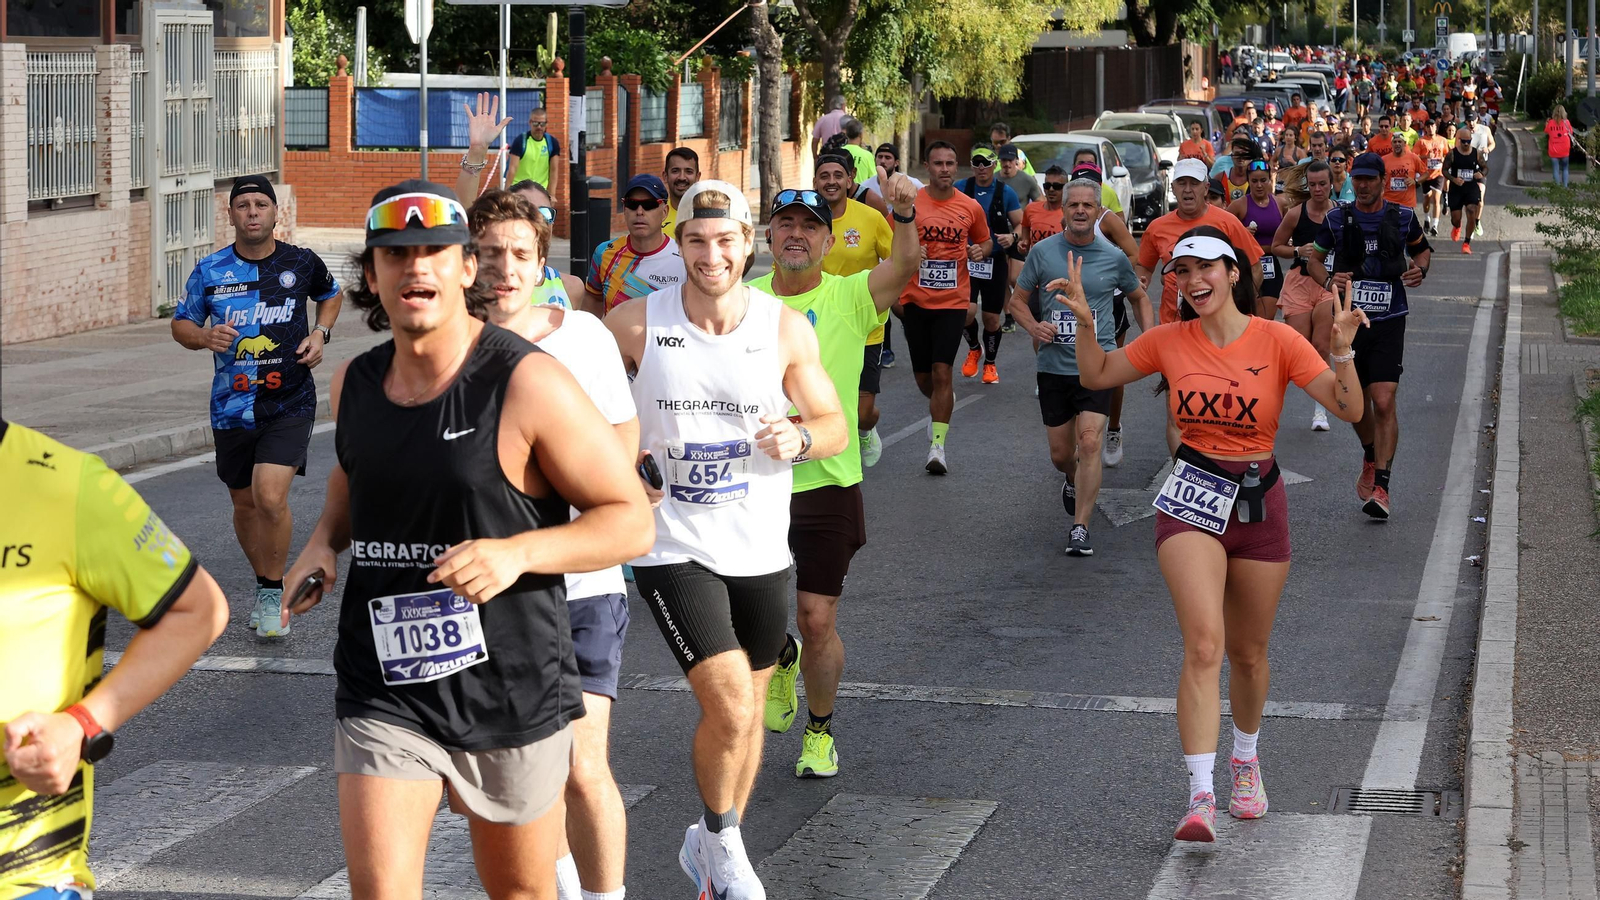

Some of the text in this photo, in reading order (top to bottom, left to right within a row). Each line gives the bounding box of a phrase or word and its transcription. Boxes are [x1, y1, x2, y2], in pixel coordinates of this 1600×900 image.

[928, 270, 948, 279] 625
[1357, 290, 1385, 302] 1100
[656, 336, 685, 348] VIGY.
[656, 399, 759, 414] THEGRAFTCLVB
[1176, 389, 1260, 423] XXIX
[1202, 418, 1244, 429] MARATÓN
[688, 461, 733, 486] 654
[1174, 480, 1220, 514] 1044
[1, 543, 33, 568] rs
[394, 619, 462, 654] 1038
[652, 589, 695, 662] THEGRAFTCLVB
